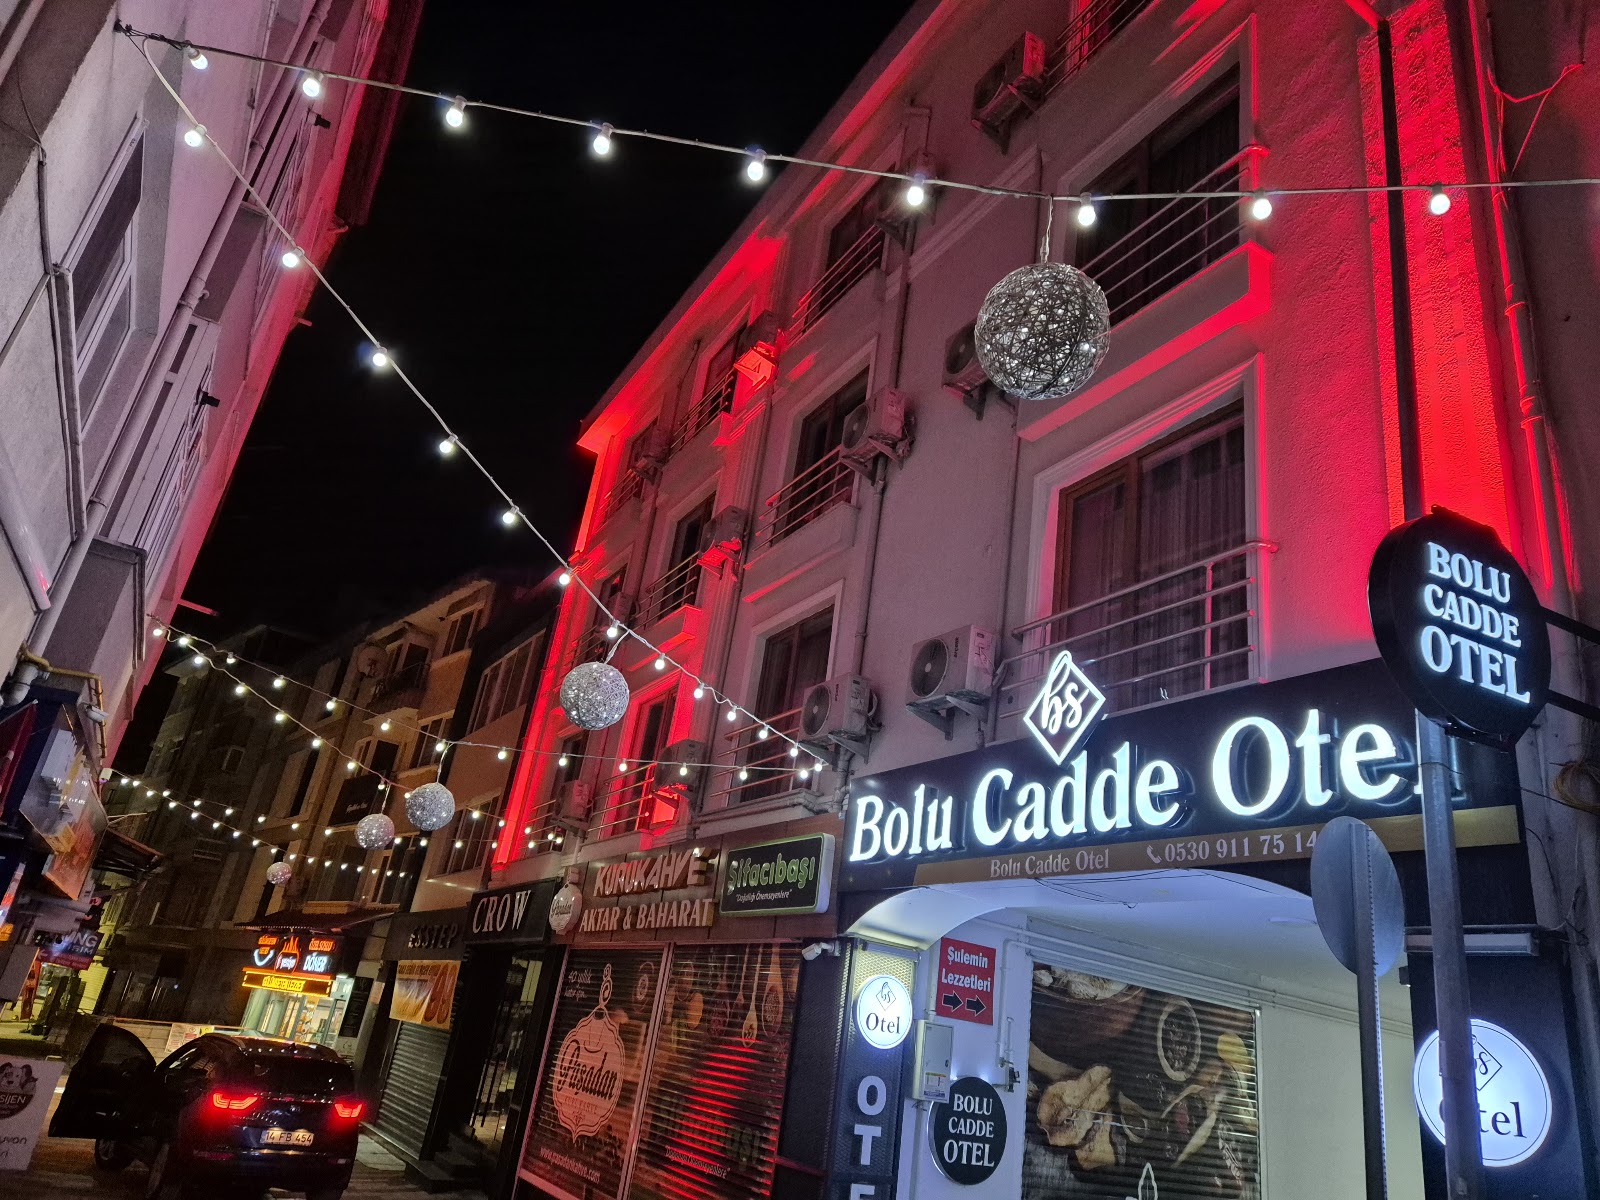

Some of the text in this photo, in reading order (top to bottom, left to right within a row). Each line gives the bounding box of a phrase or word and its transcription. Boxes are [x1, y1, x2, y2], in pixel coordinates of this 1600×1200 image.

[1427, 541, 1511, 604] BOLU
[1423, 583, 1522, 648] CADDE
[1420, 625, 1531, 704] OTEL
[849, 708, 1424, 862] Bolu Cadde Ote
[1164, 831, 1317, 862] 0530 911 75 14
[593, 847, 706, 897] KURUKAHVE
[990, 849, 1110, 878] Bolu Cadde Otel
[472, 889, 532, 934] CROW
[579, 898, 714, 932] AKTAR & BAHARAT
[947, 946, 989, 970] Şulemin
[941, 968, 992, 993] Lezzetleri
[866, 1012, 901, 1035] Otel
[953, 1093, 993, 1116] BOLU
[1439, 1101, 1527, 1139] tel
[266, 1132, 312, 1143] 14 FB 454
[948, 1117, 995, 1139] CADDE
[943, 1139, 995, 1168] OTEL
